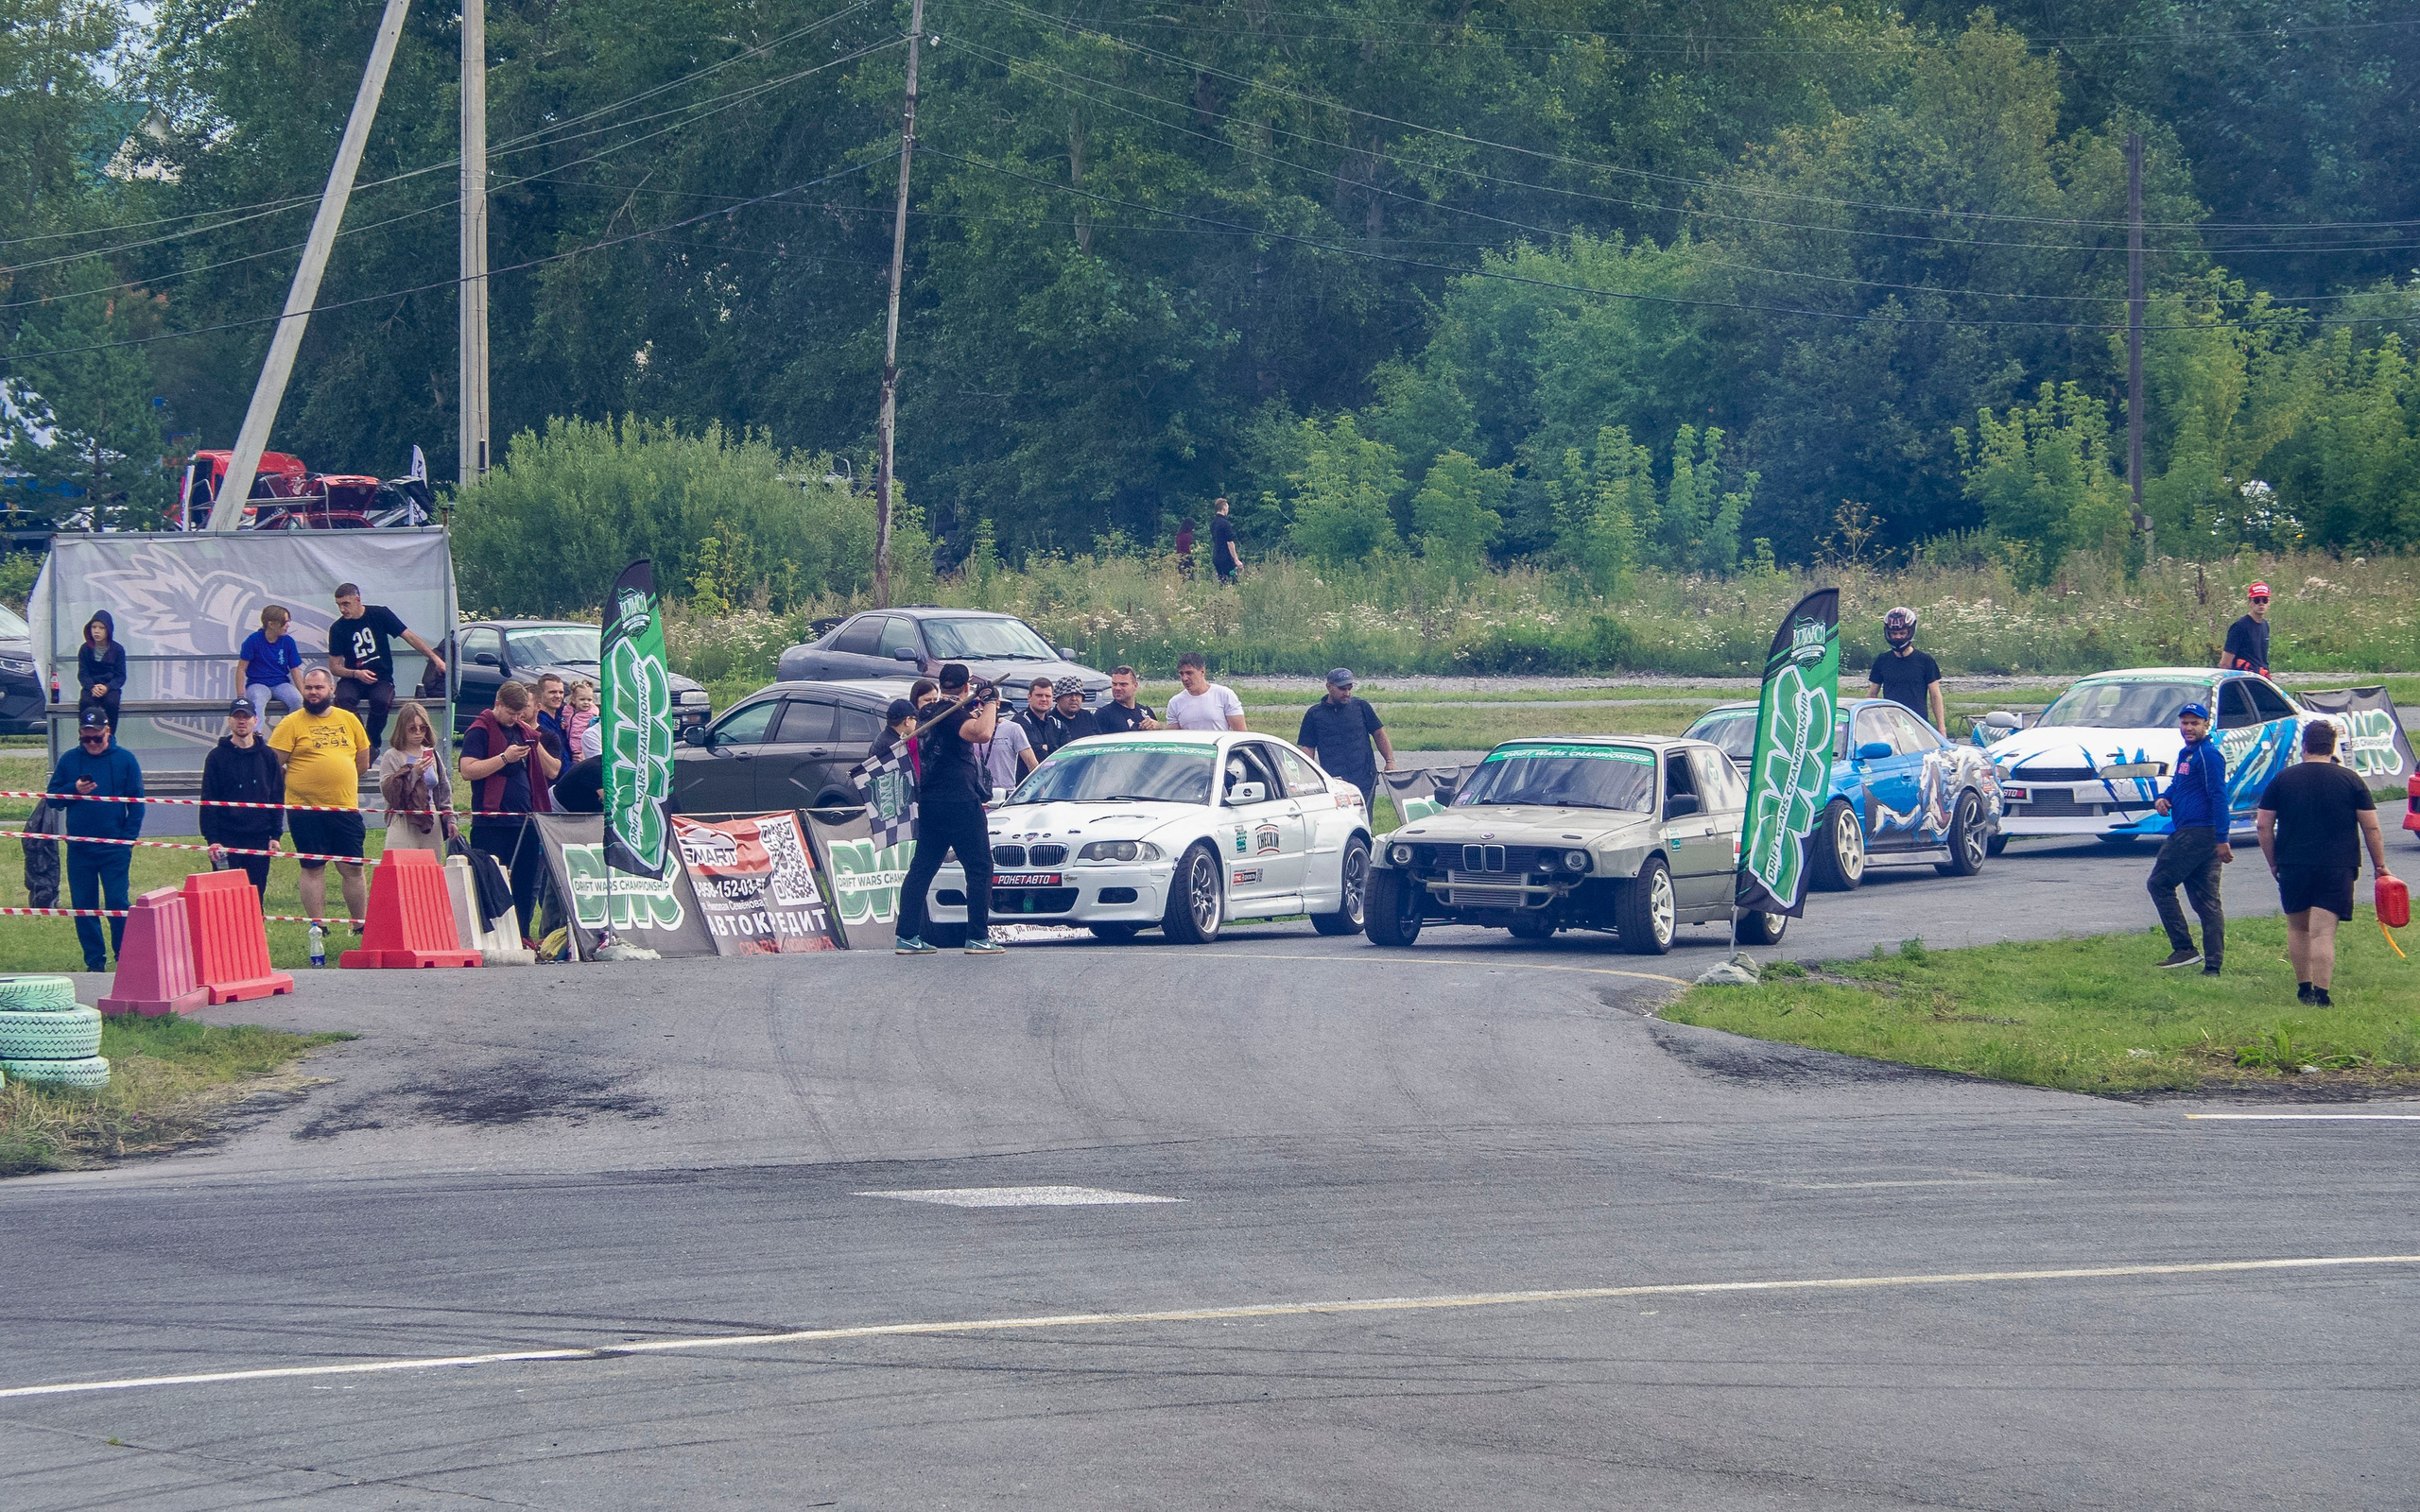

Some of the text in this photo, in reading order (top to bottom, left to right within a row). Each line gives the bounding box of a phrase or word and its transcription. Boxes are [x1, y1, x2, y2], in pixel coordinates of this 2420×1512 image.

[353, 627, 376, 659] 29
[631, 662, 649, 847] DRIFT WARS CHAMPIONSHIP
[1134, 747, 1214, 755] CHAMPIONSHIP
[1568, 751, 1651, 763] CHAMPIONSHIP
[1768, 693, 1808, 881] DRIFT WARS CHAMPIONSHIP
[1257, 832, 1273, 850] CHECK
[684, 848, 737, 866] SMART
[575, 881, 594, 892] DRIFT
[619, 880, 669, 892] CHAMPIONSHIP
[838, 877, 856, 887] DRIFT
[857, 874, 882, 887] WARS
[707, 908, 826, 936] АВТОКРЕДИТ
